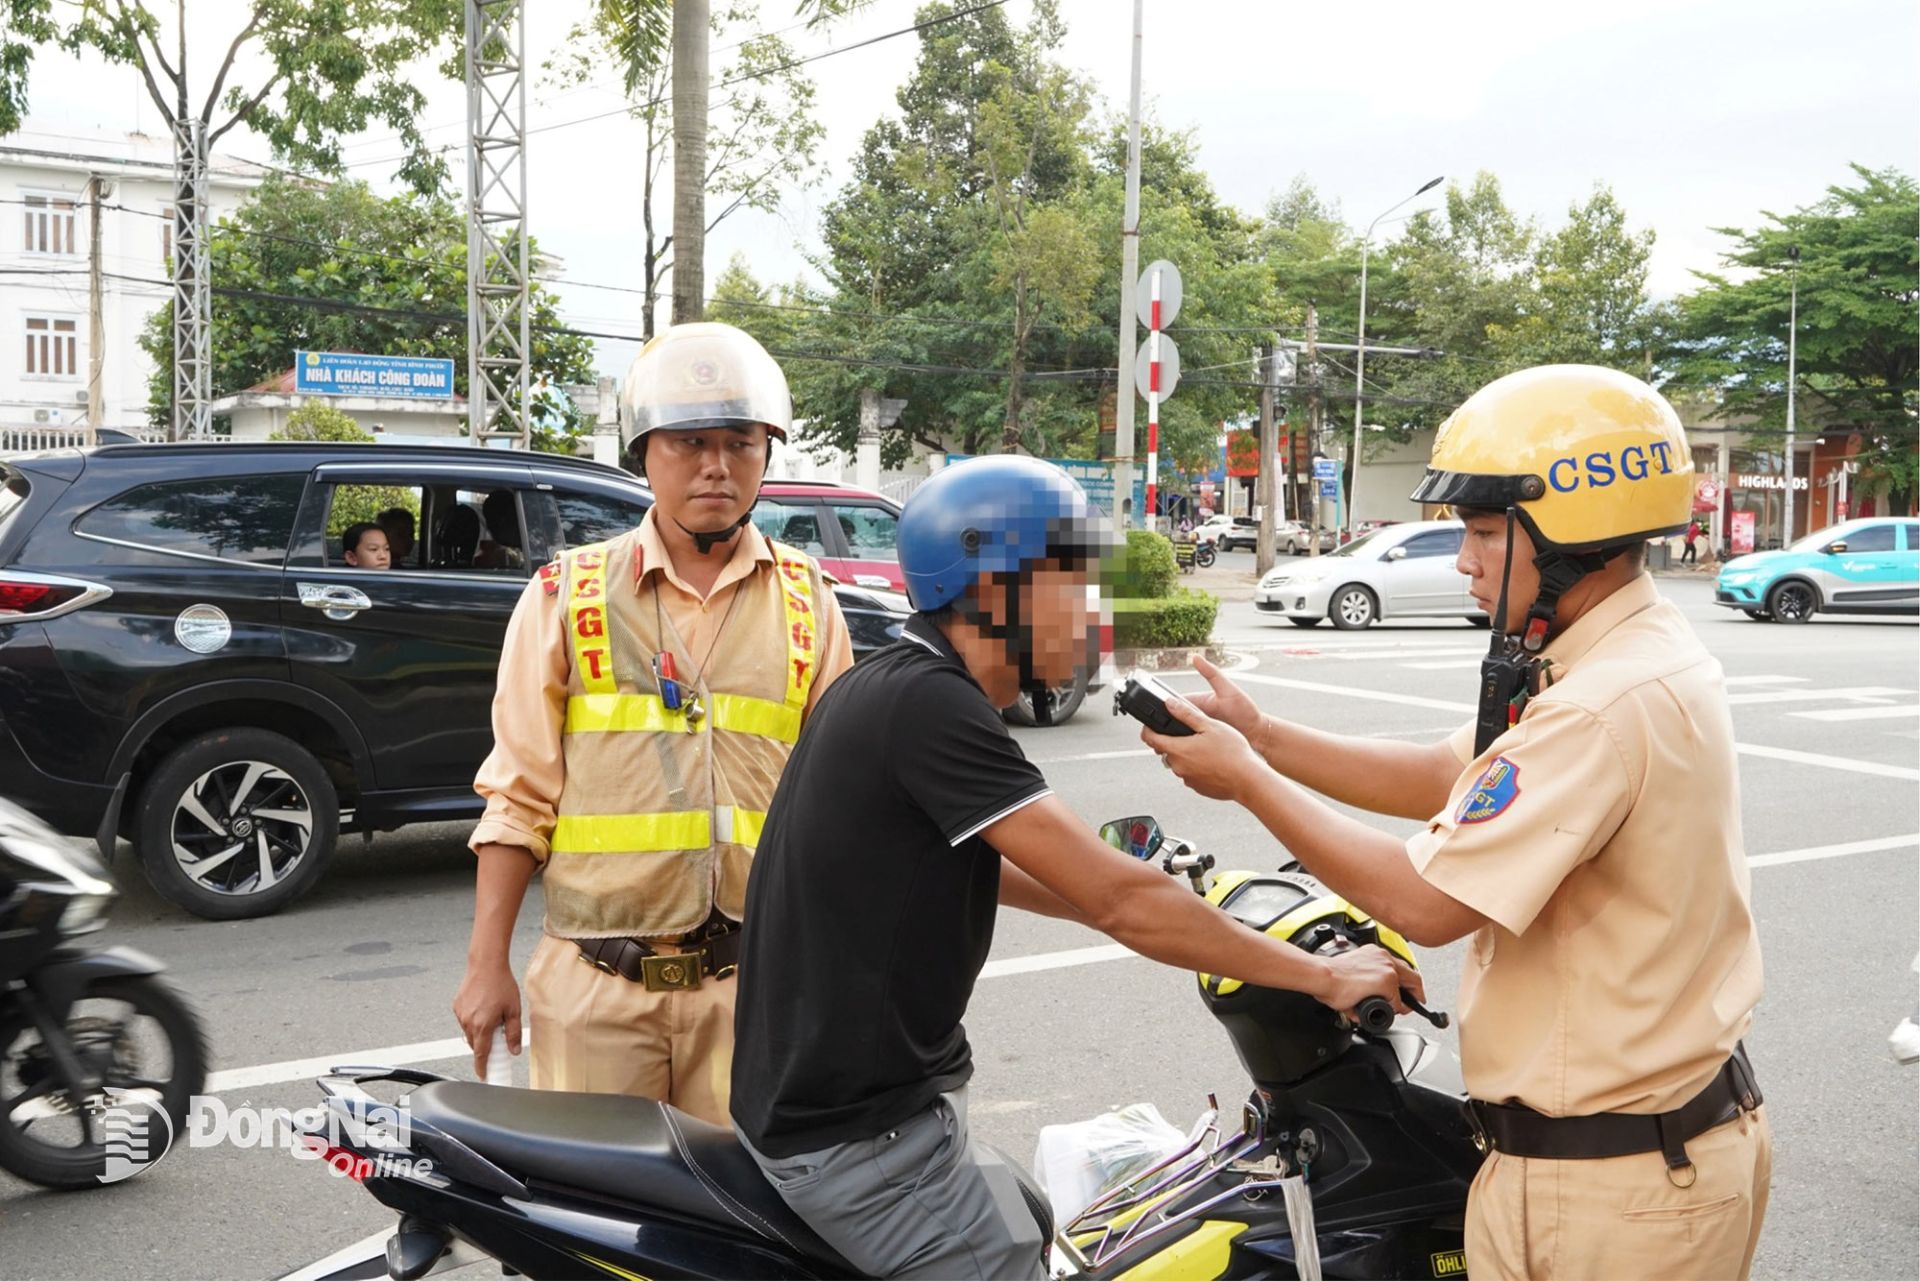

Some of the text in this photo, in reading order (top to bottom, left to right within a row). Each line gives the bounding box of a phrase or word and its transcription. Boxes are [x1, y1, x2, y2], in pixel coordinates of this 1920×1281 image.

[305, 366, 446, 388] NHÀ KHÁCH CÔNG ĐOÀN
[1548, 441, 1673, 493] CSGT
[1738, 475, 1808, 490] HIGHLADS
[575, 551, 605, 681] CSGT
[782, 557, 812, 690] CSGT
[1436, 1255, 1467, 1274] ÖHLI
